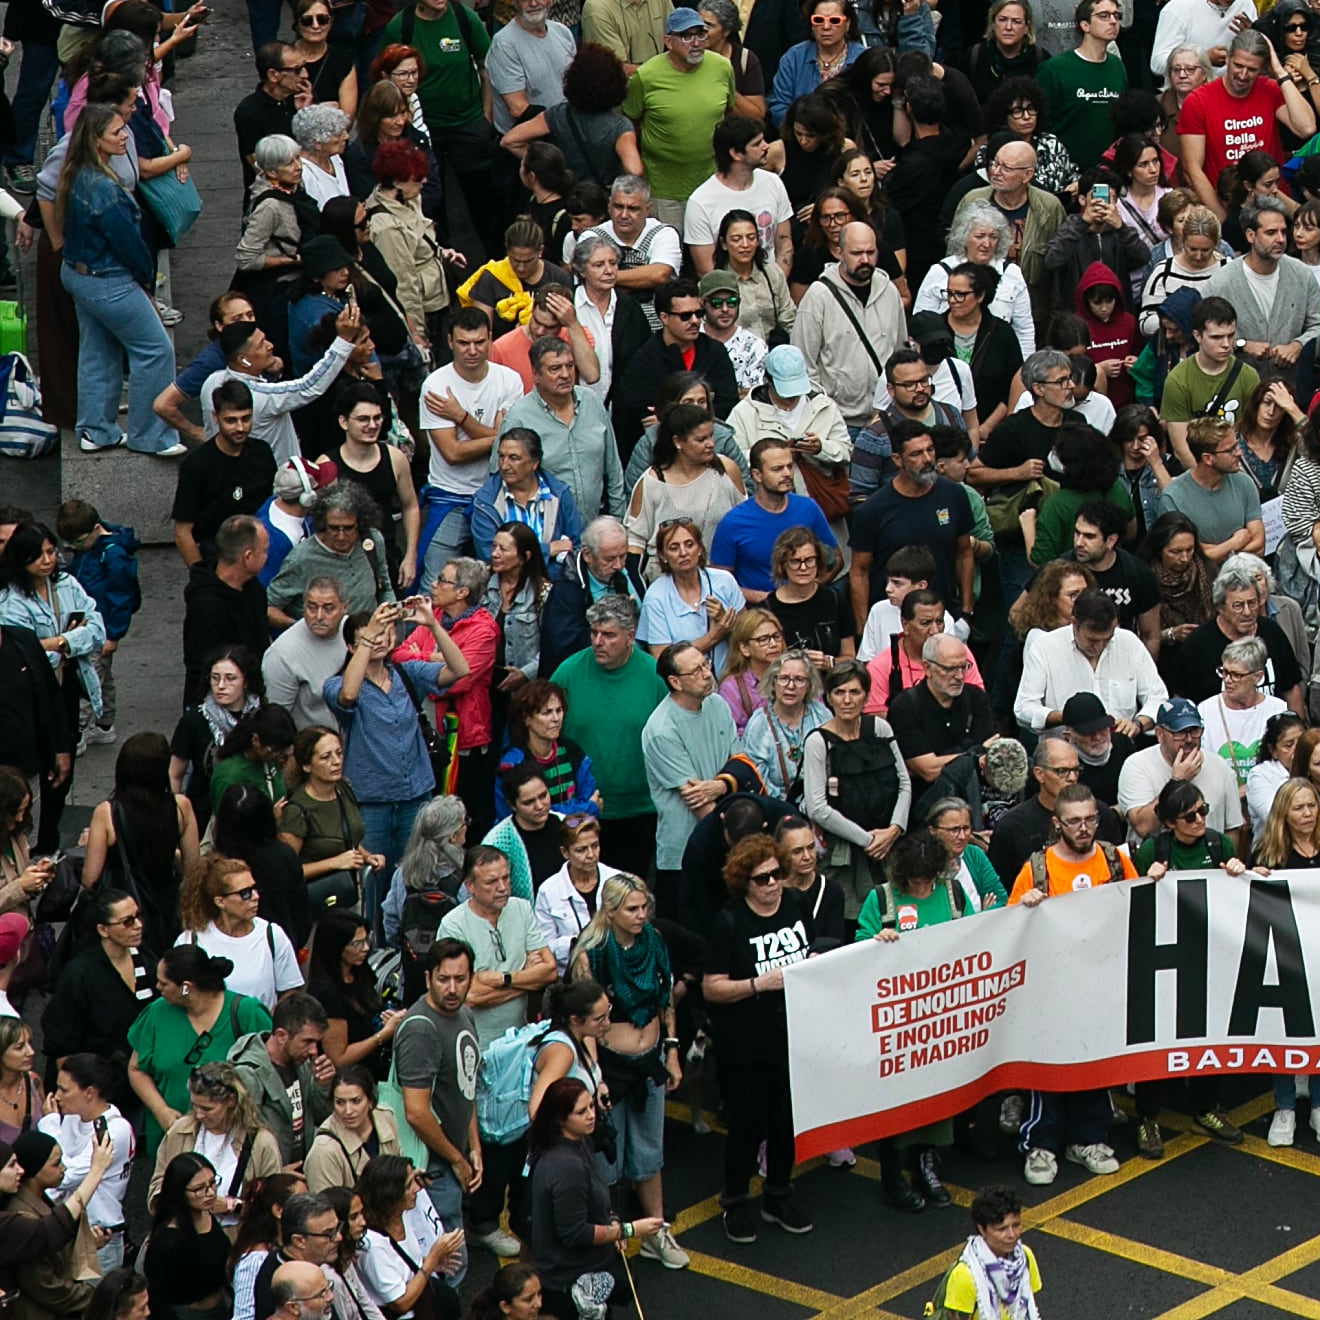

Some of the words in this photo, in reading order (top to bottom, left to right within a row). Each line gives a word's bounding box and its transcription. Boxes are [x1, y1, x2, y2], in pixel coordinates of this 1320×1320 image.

[1224, 116, 1264, 131] Circolo
[1225, 133, 1256, 146] Bella
[749, 919, 810, 961] 7291
[900, 921, 918, 930] CGT
[876, 951, 992, 999] SINDICATO
[878, 1003, 907, 1028] DE
[910, 964, 1022, 1021] INQUILINAS
[880, 1035, 891, 1055] E
[896, 998, 1007, 1049] INQUILINOS
[880, 1057, 905, 1079] DE
[910, 1029, 989, 1069] MADRID
